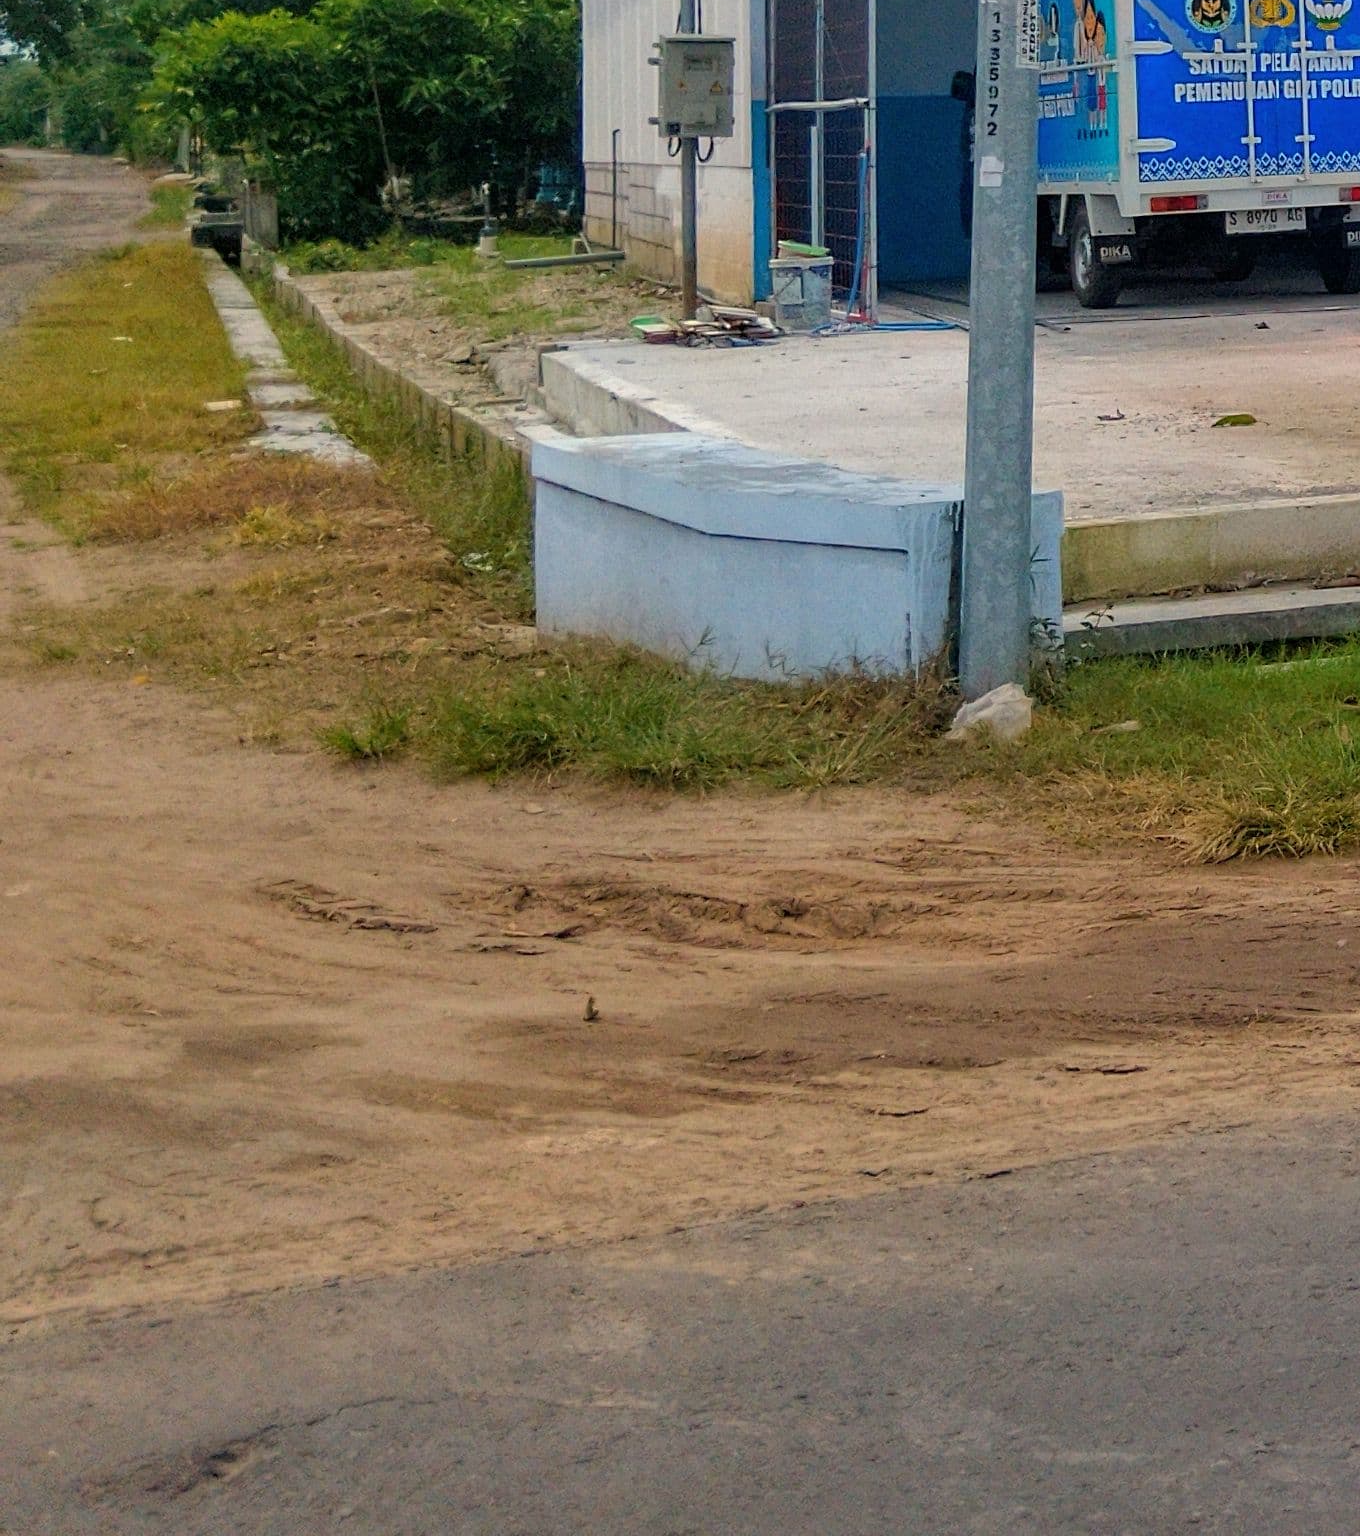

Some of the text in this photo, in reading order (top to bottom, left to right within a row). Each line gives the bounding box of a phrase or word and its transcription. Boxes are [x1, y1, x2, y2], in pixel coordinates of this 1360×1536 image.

[1260, 52, 1354, 72] PELAANAN
[1229, 211, 1238, 225] S
[1100, 245, 1132, 257] DIKA
